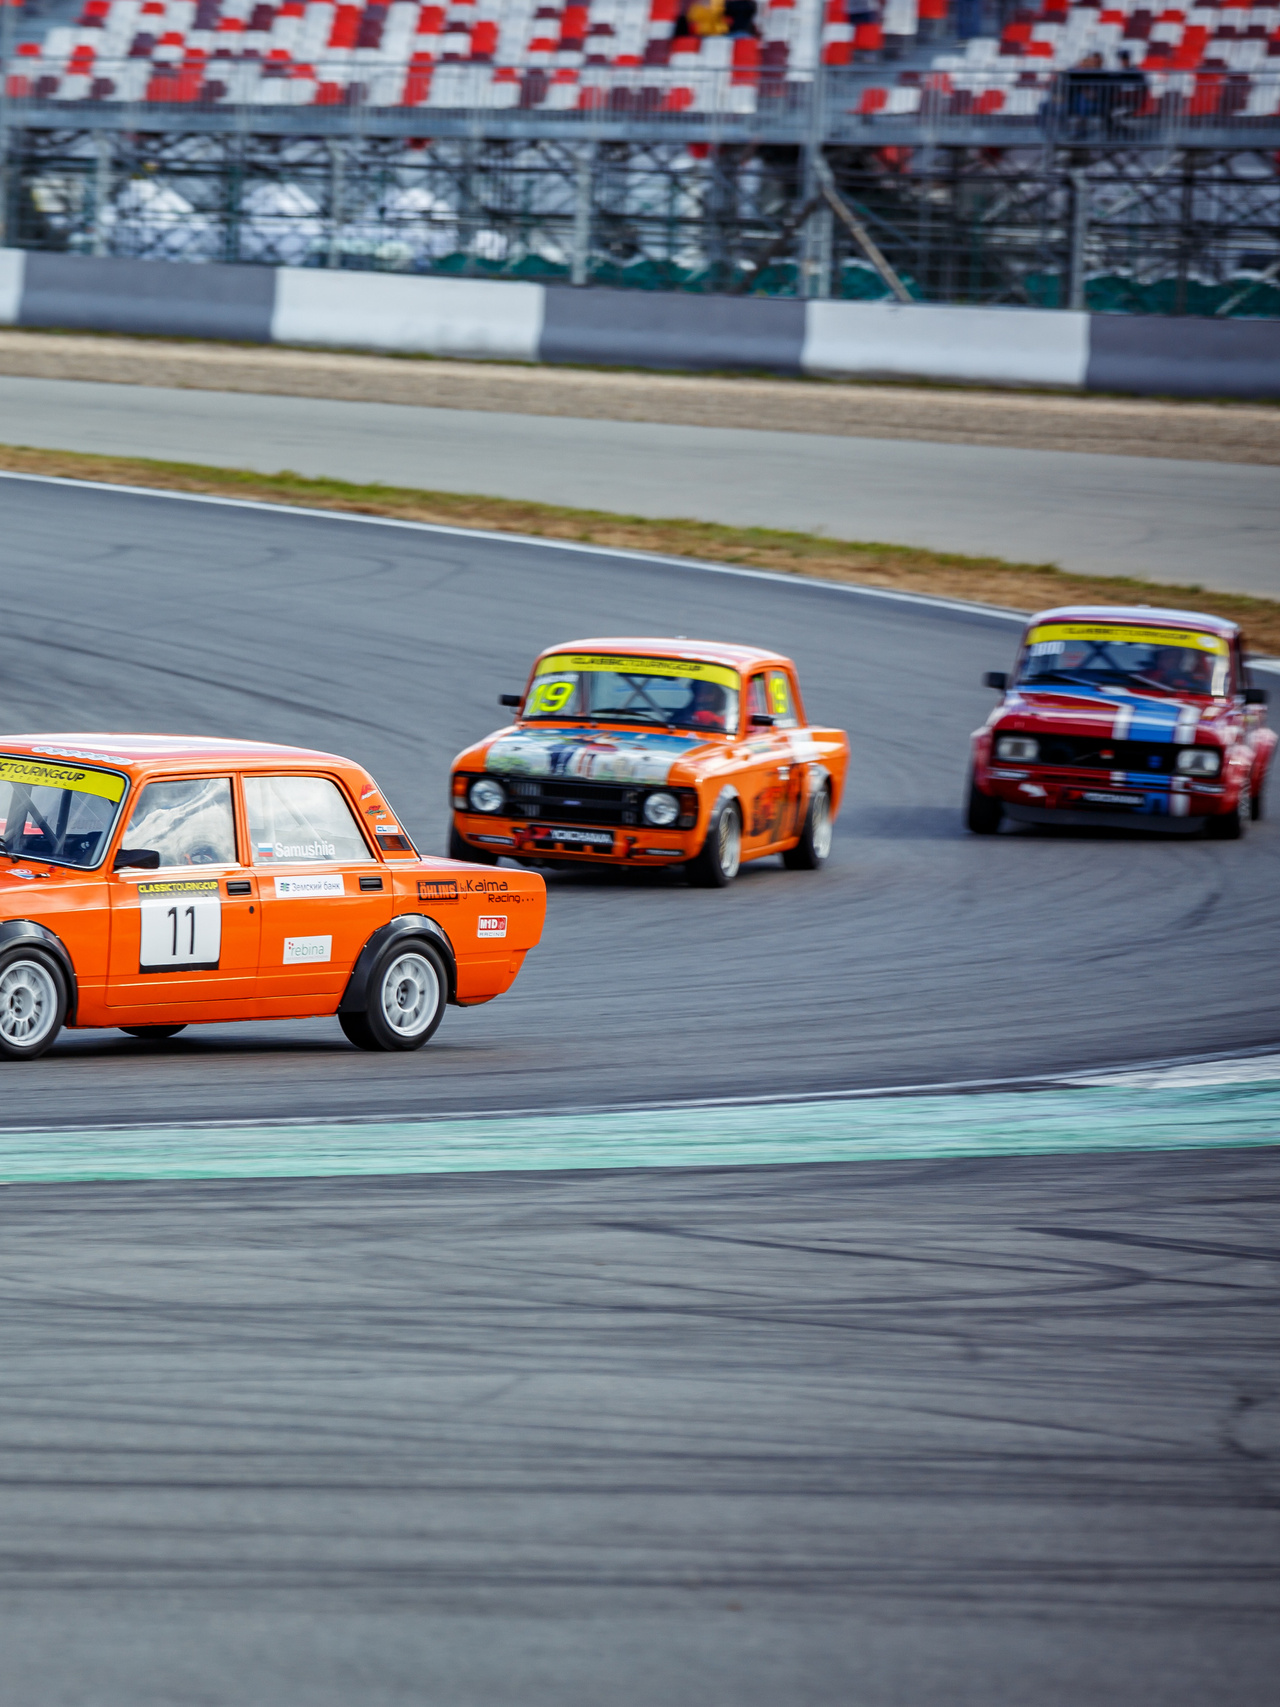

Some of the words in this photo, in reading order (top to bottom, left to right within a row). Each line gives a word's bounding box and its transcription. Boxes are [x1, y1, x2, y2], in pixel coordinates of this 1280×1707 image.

[528, 681, 575, 713] 19
[292, 881, 322, 891] Земский
[323, 881, 340, 890] банк
[420, 883, 457, 900] ÖHLINS
[167, 906, 195, 956] 11
[480, 919, 498, 929] M1D
[290, 943, 324, 956] rebina
